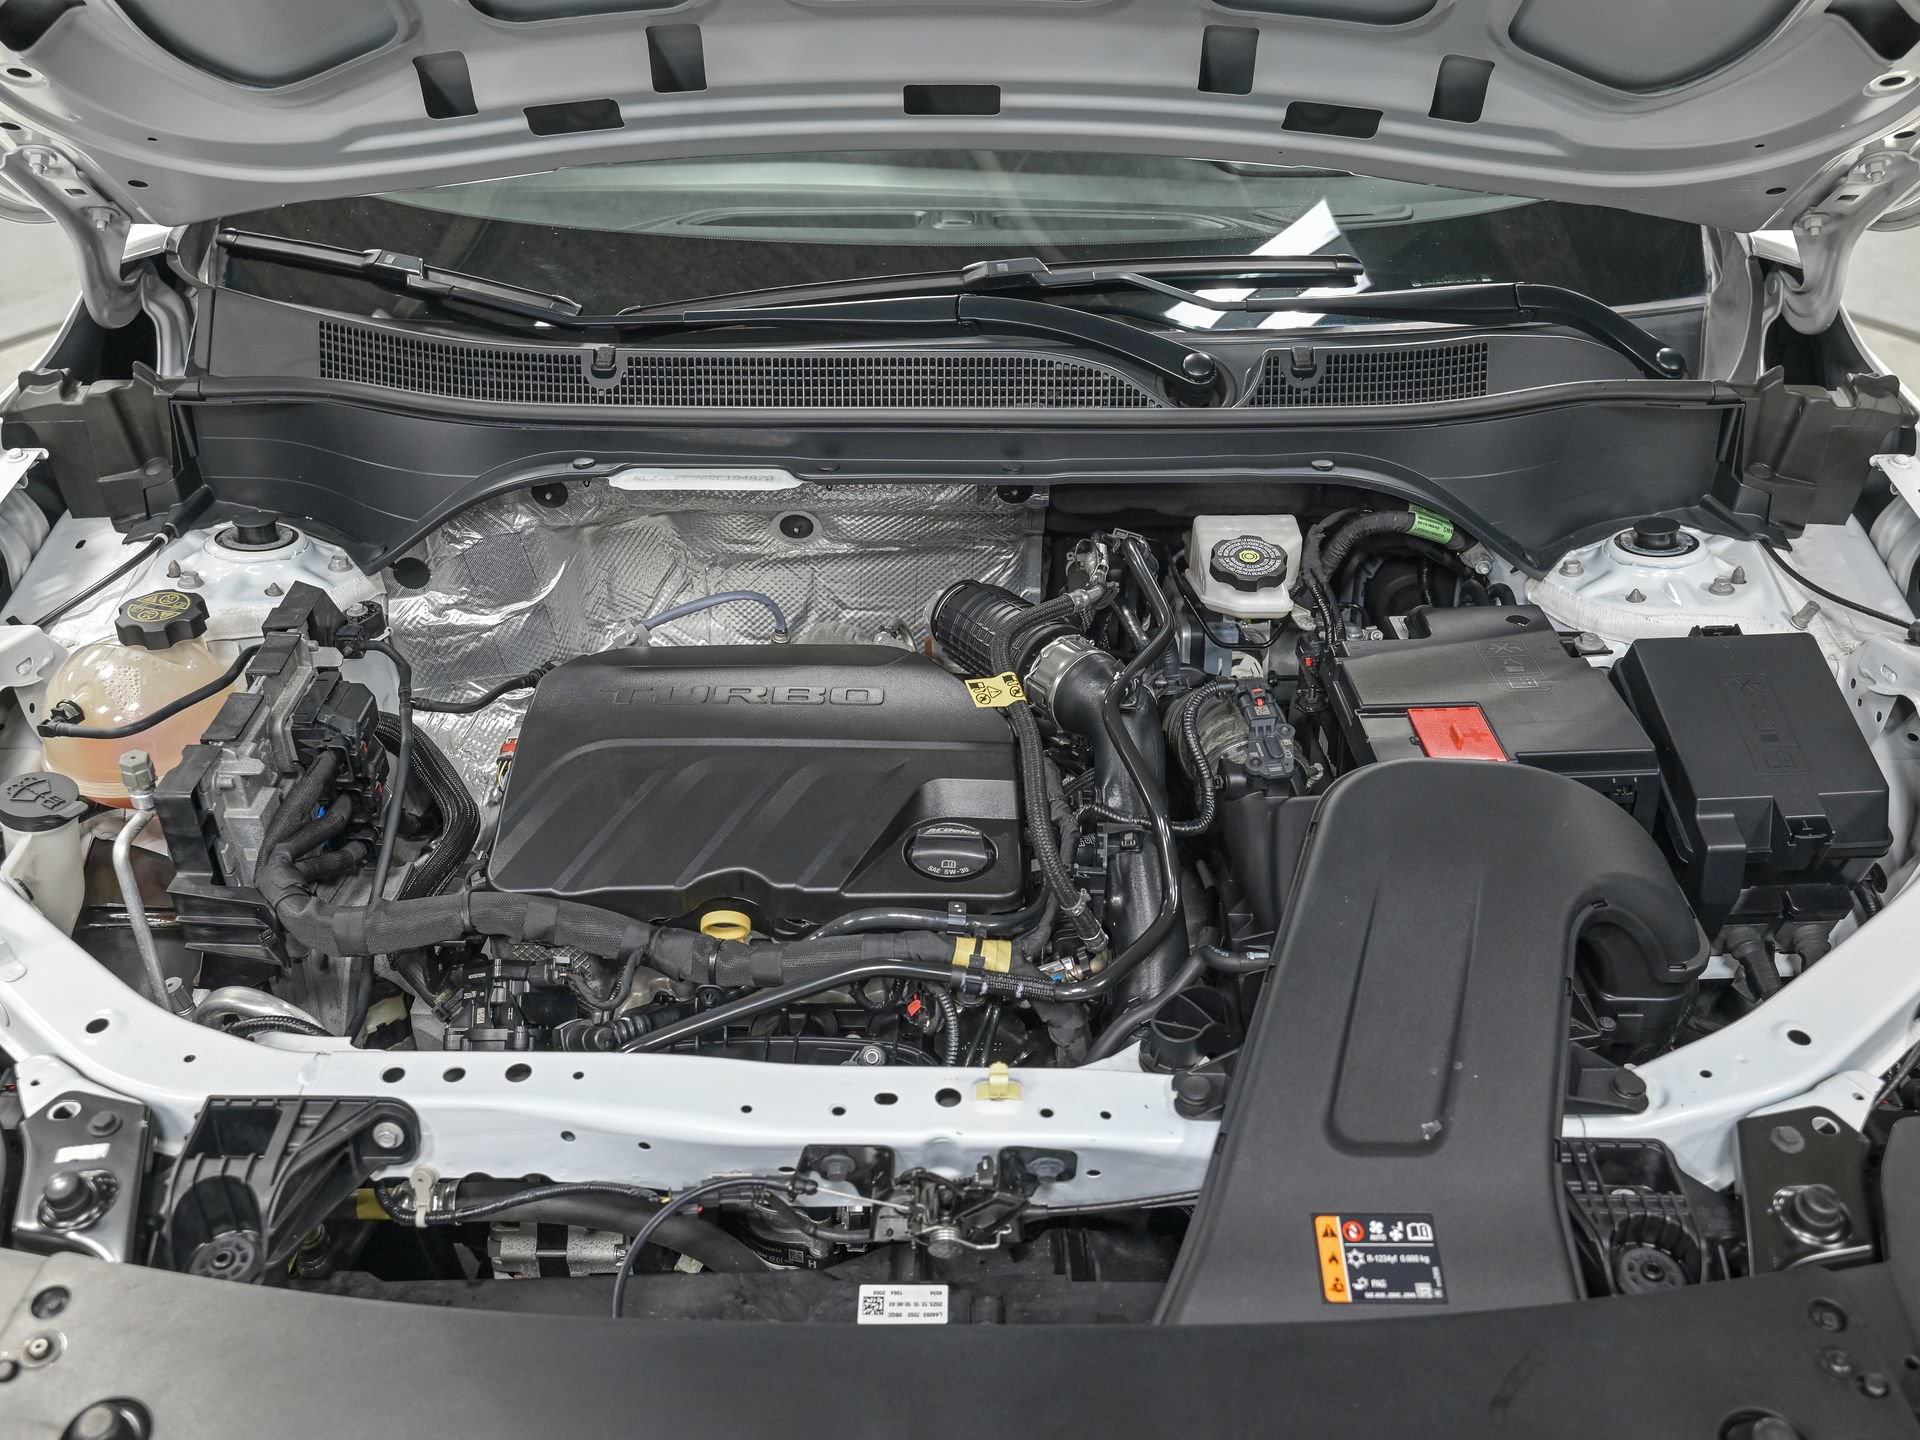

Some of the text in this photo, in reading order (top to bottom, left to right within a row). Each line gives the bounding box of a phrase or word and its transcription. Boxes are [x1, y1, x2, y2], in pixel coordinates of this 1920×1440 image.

[598, 686, 885, 706] TURBO
[923, 828, 980, 836] ACDelco
[927, 865, 970, 875] SAE 5W-30
